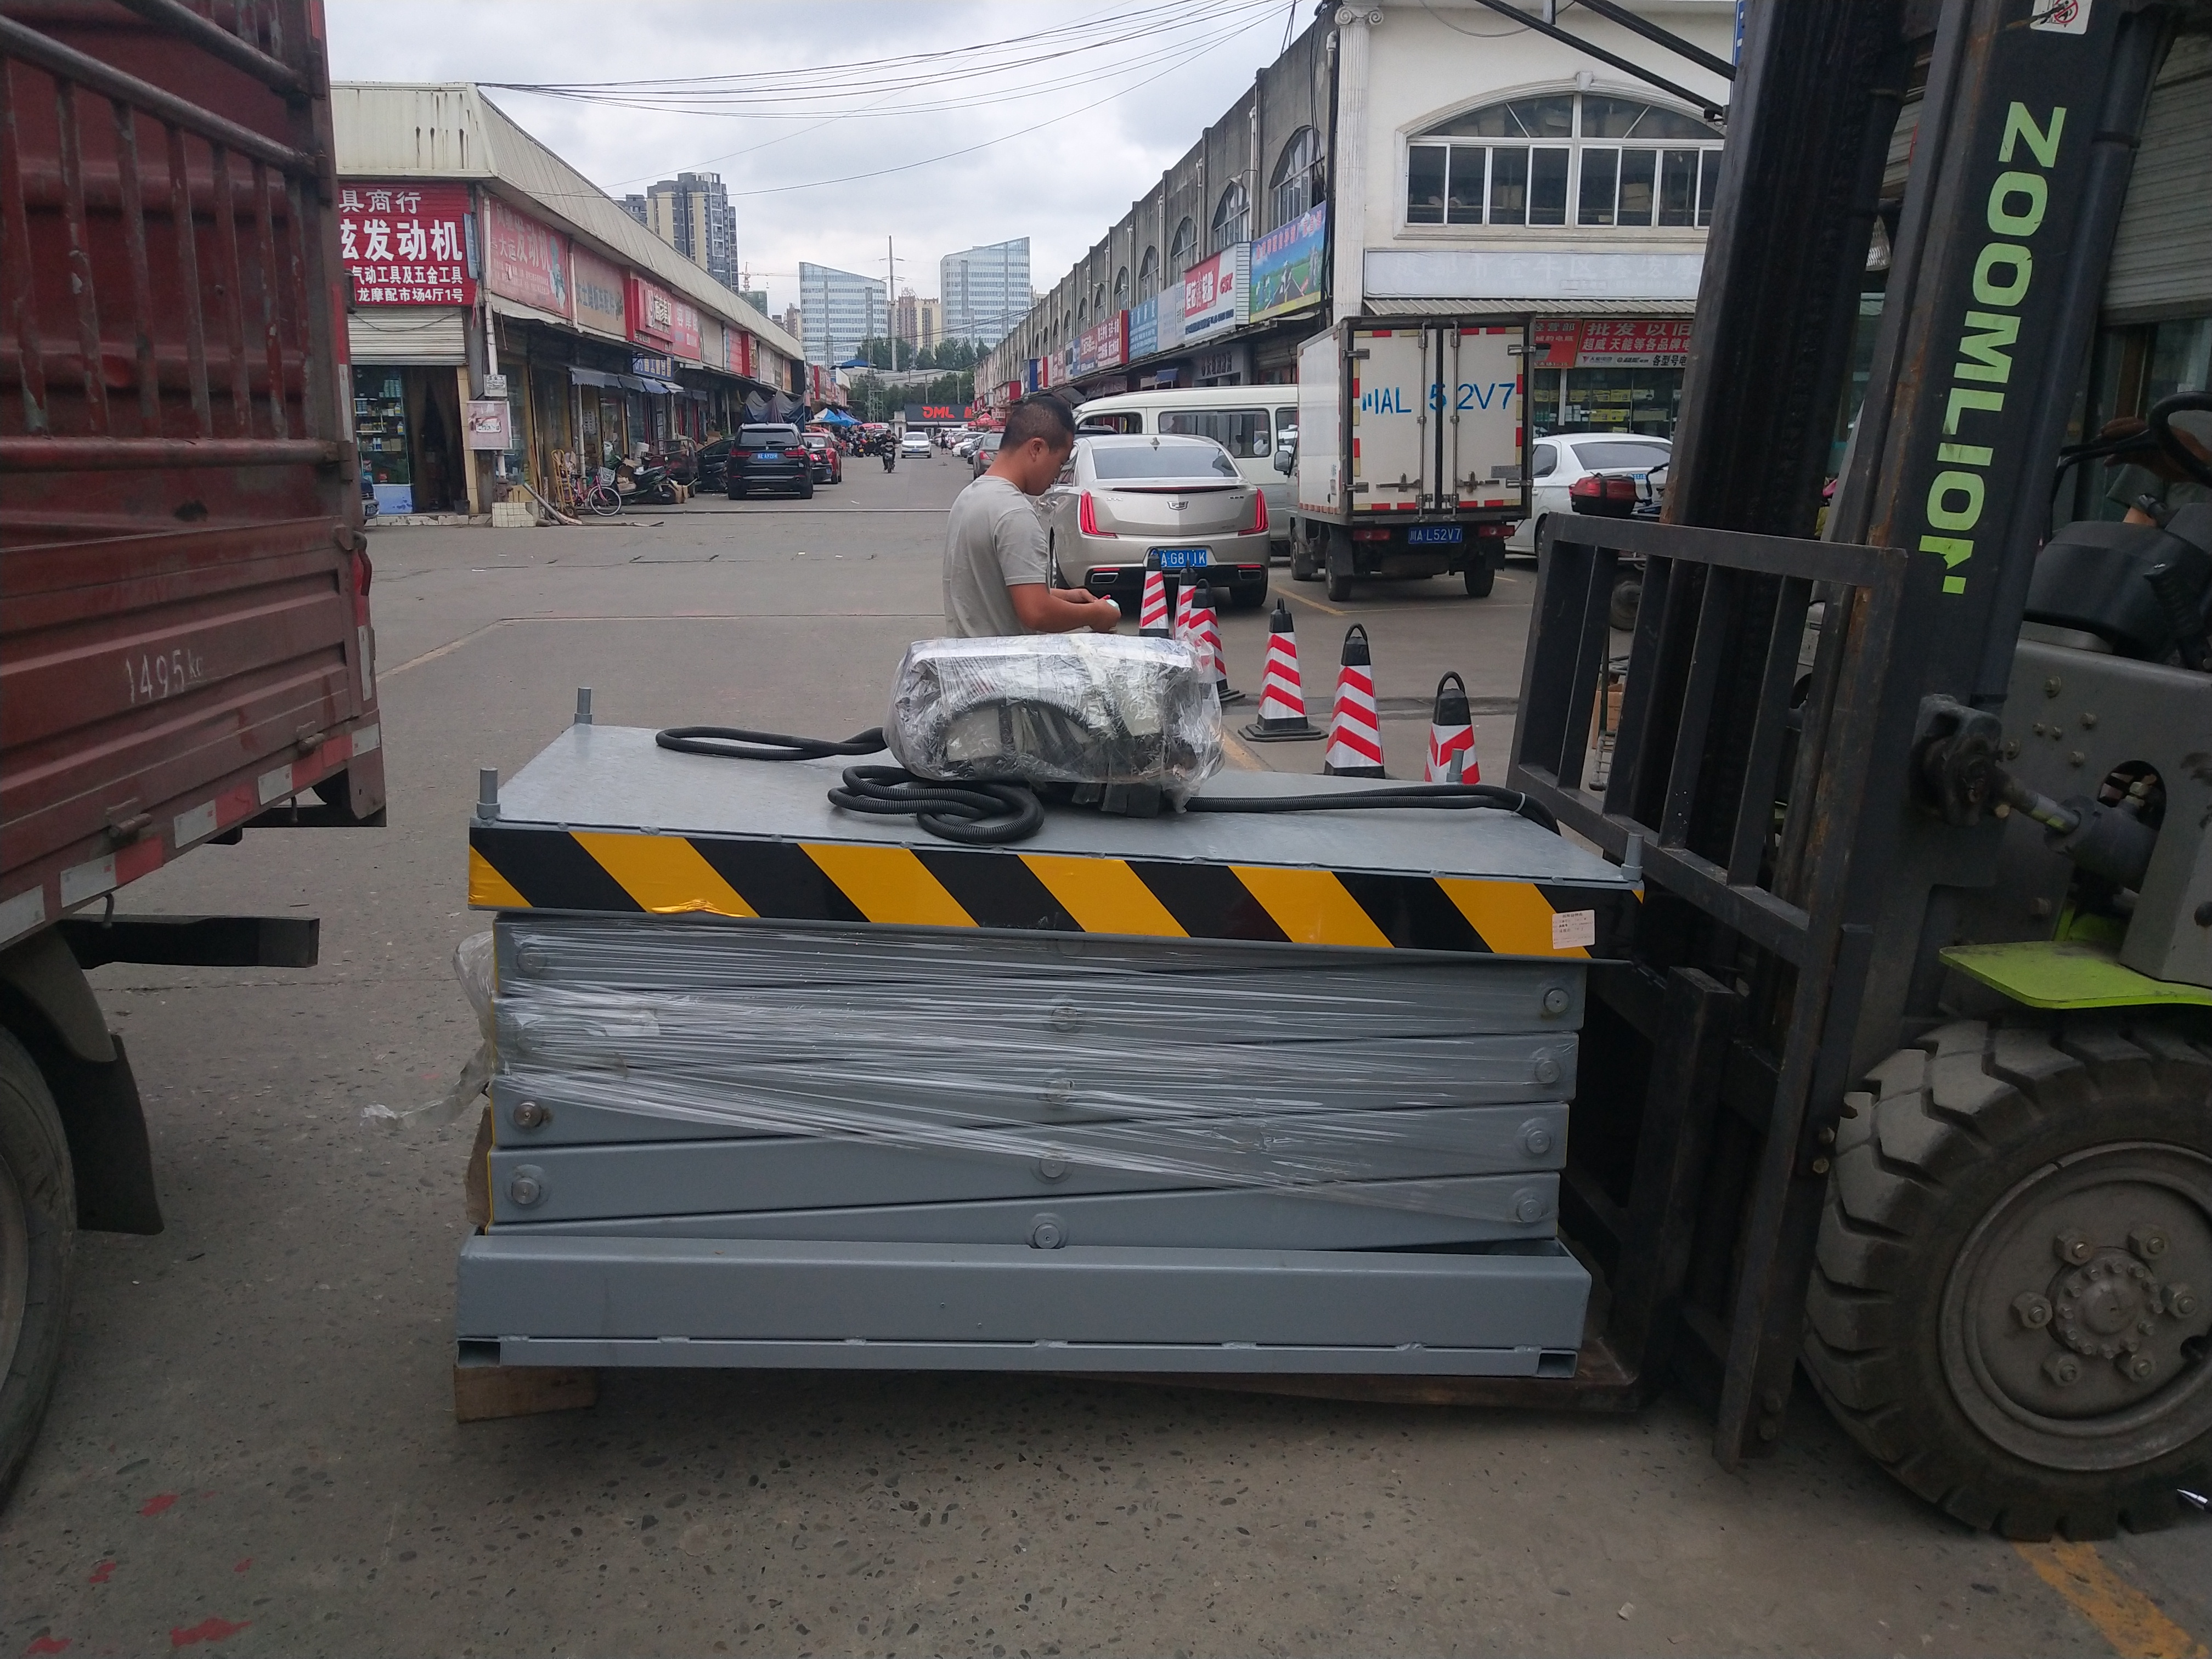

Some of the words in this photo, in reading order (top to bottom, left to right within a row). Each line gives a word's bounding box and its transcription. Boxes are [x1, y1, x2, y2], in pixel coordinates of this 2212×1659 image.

[338, 189, 422, 214] 具商行
[357, 287, 464, 303] 龙摩配市场4厅1号
[1587, 323, 1637, 336] 批发
[1645, 323, 1692, 336] 以旧
[1582, 337, 1607, 351] 超威
